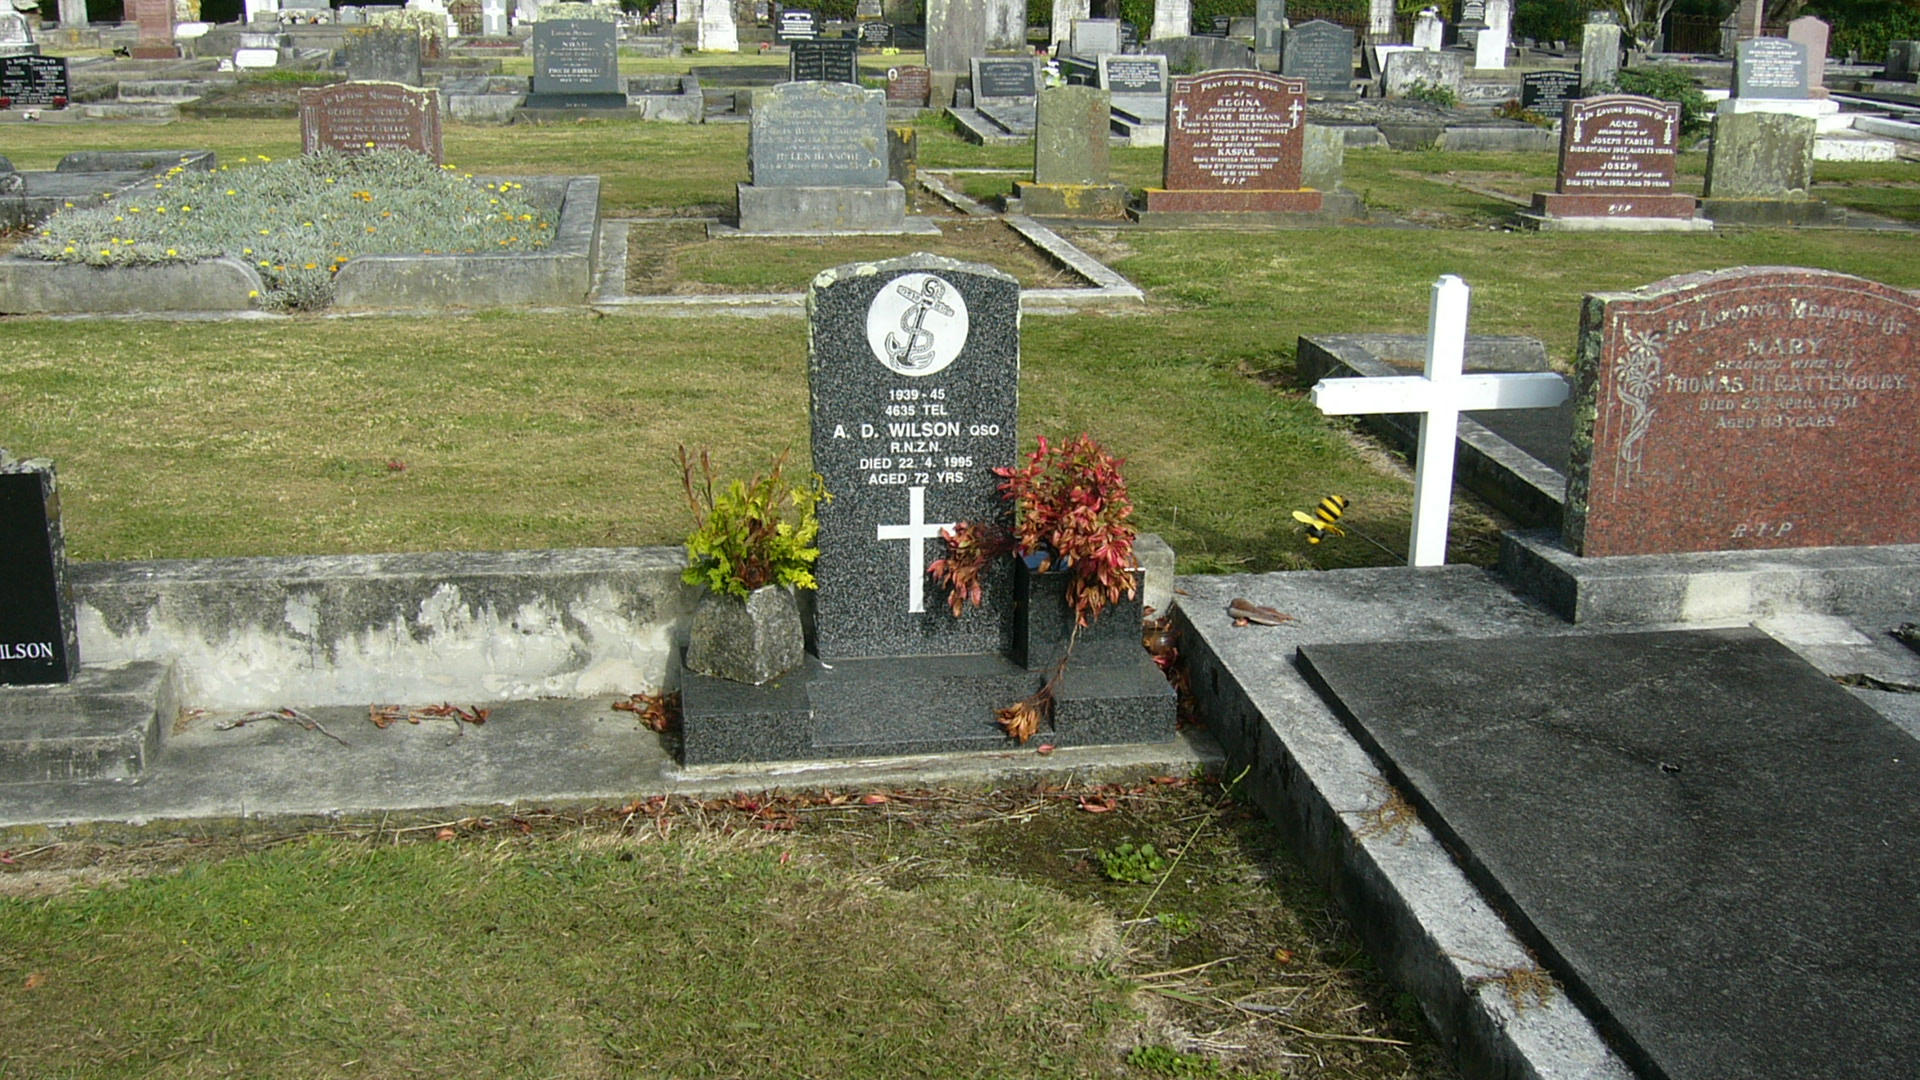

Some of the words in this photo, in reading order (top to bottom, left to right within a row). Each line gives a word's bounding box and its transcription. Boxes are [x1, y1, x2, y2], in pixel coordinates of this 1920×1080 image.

[1201, 81, 1222, 93] PRAY
[1258, 81, 1280, 92] SOUL
[1217, 99, 1261, 107] REGINA
[327, 108, 363, 116] GEORGE
[1585, 112, 1594, 121] IN
[1596, 107, 1623, 117] LOVING
[1625, 106, 1653, 117] MEMORY
[1654, 112, 1664, 120] OF
[1609, 120, 1639, 128] AGNES
[1591, 137, 1621, 145] JOSEPH
[1600, 162, 1639, 170] JOSEPH
[1667, 319, 1689, 341] IN
[1697, 303, 1778, 331] LOVING
[1789, 297, 1878, 326] MEMORY
[1881, 315, 1907, 336] OF
[1746, 337, 1828, 356] MARY
[1665, 373, 1744, 393] THOMAS
[1774, 373, 1908, 392] RATTENBURY
[889, 389, 919, 400] 1939
[929, 388, 945, 400] 45
[885, 405, 915, 416] 4635
[922, 404, 948, 416] TEL
[1700, 399, 1736, 411] DIED
[1716, 416, 1755, 429] AGED
[833, 424, 850, 439] A.
[861, 424, 880, 439] D.
[888, 422, 960, 437] WILSON
[969, 424, 999, 437] QSO
[859, 458, 892, 470] DIED
[943, 456, 973, 468] 1995
[868, 473, 907, 485] AGED
[914, 472, 929, 484] 72
[936, 472, 964, 484] YRS
[0, 642, 53, 660] ILSON
